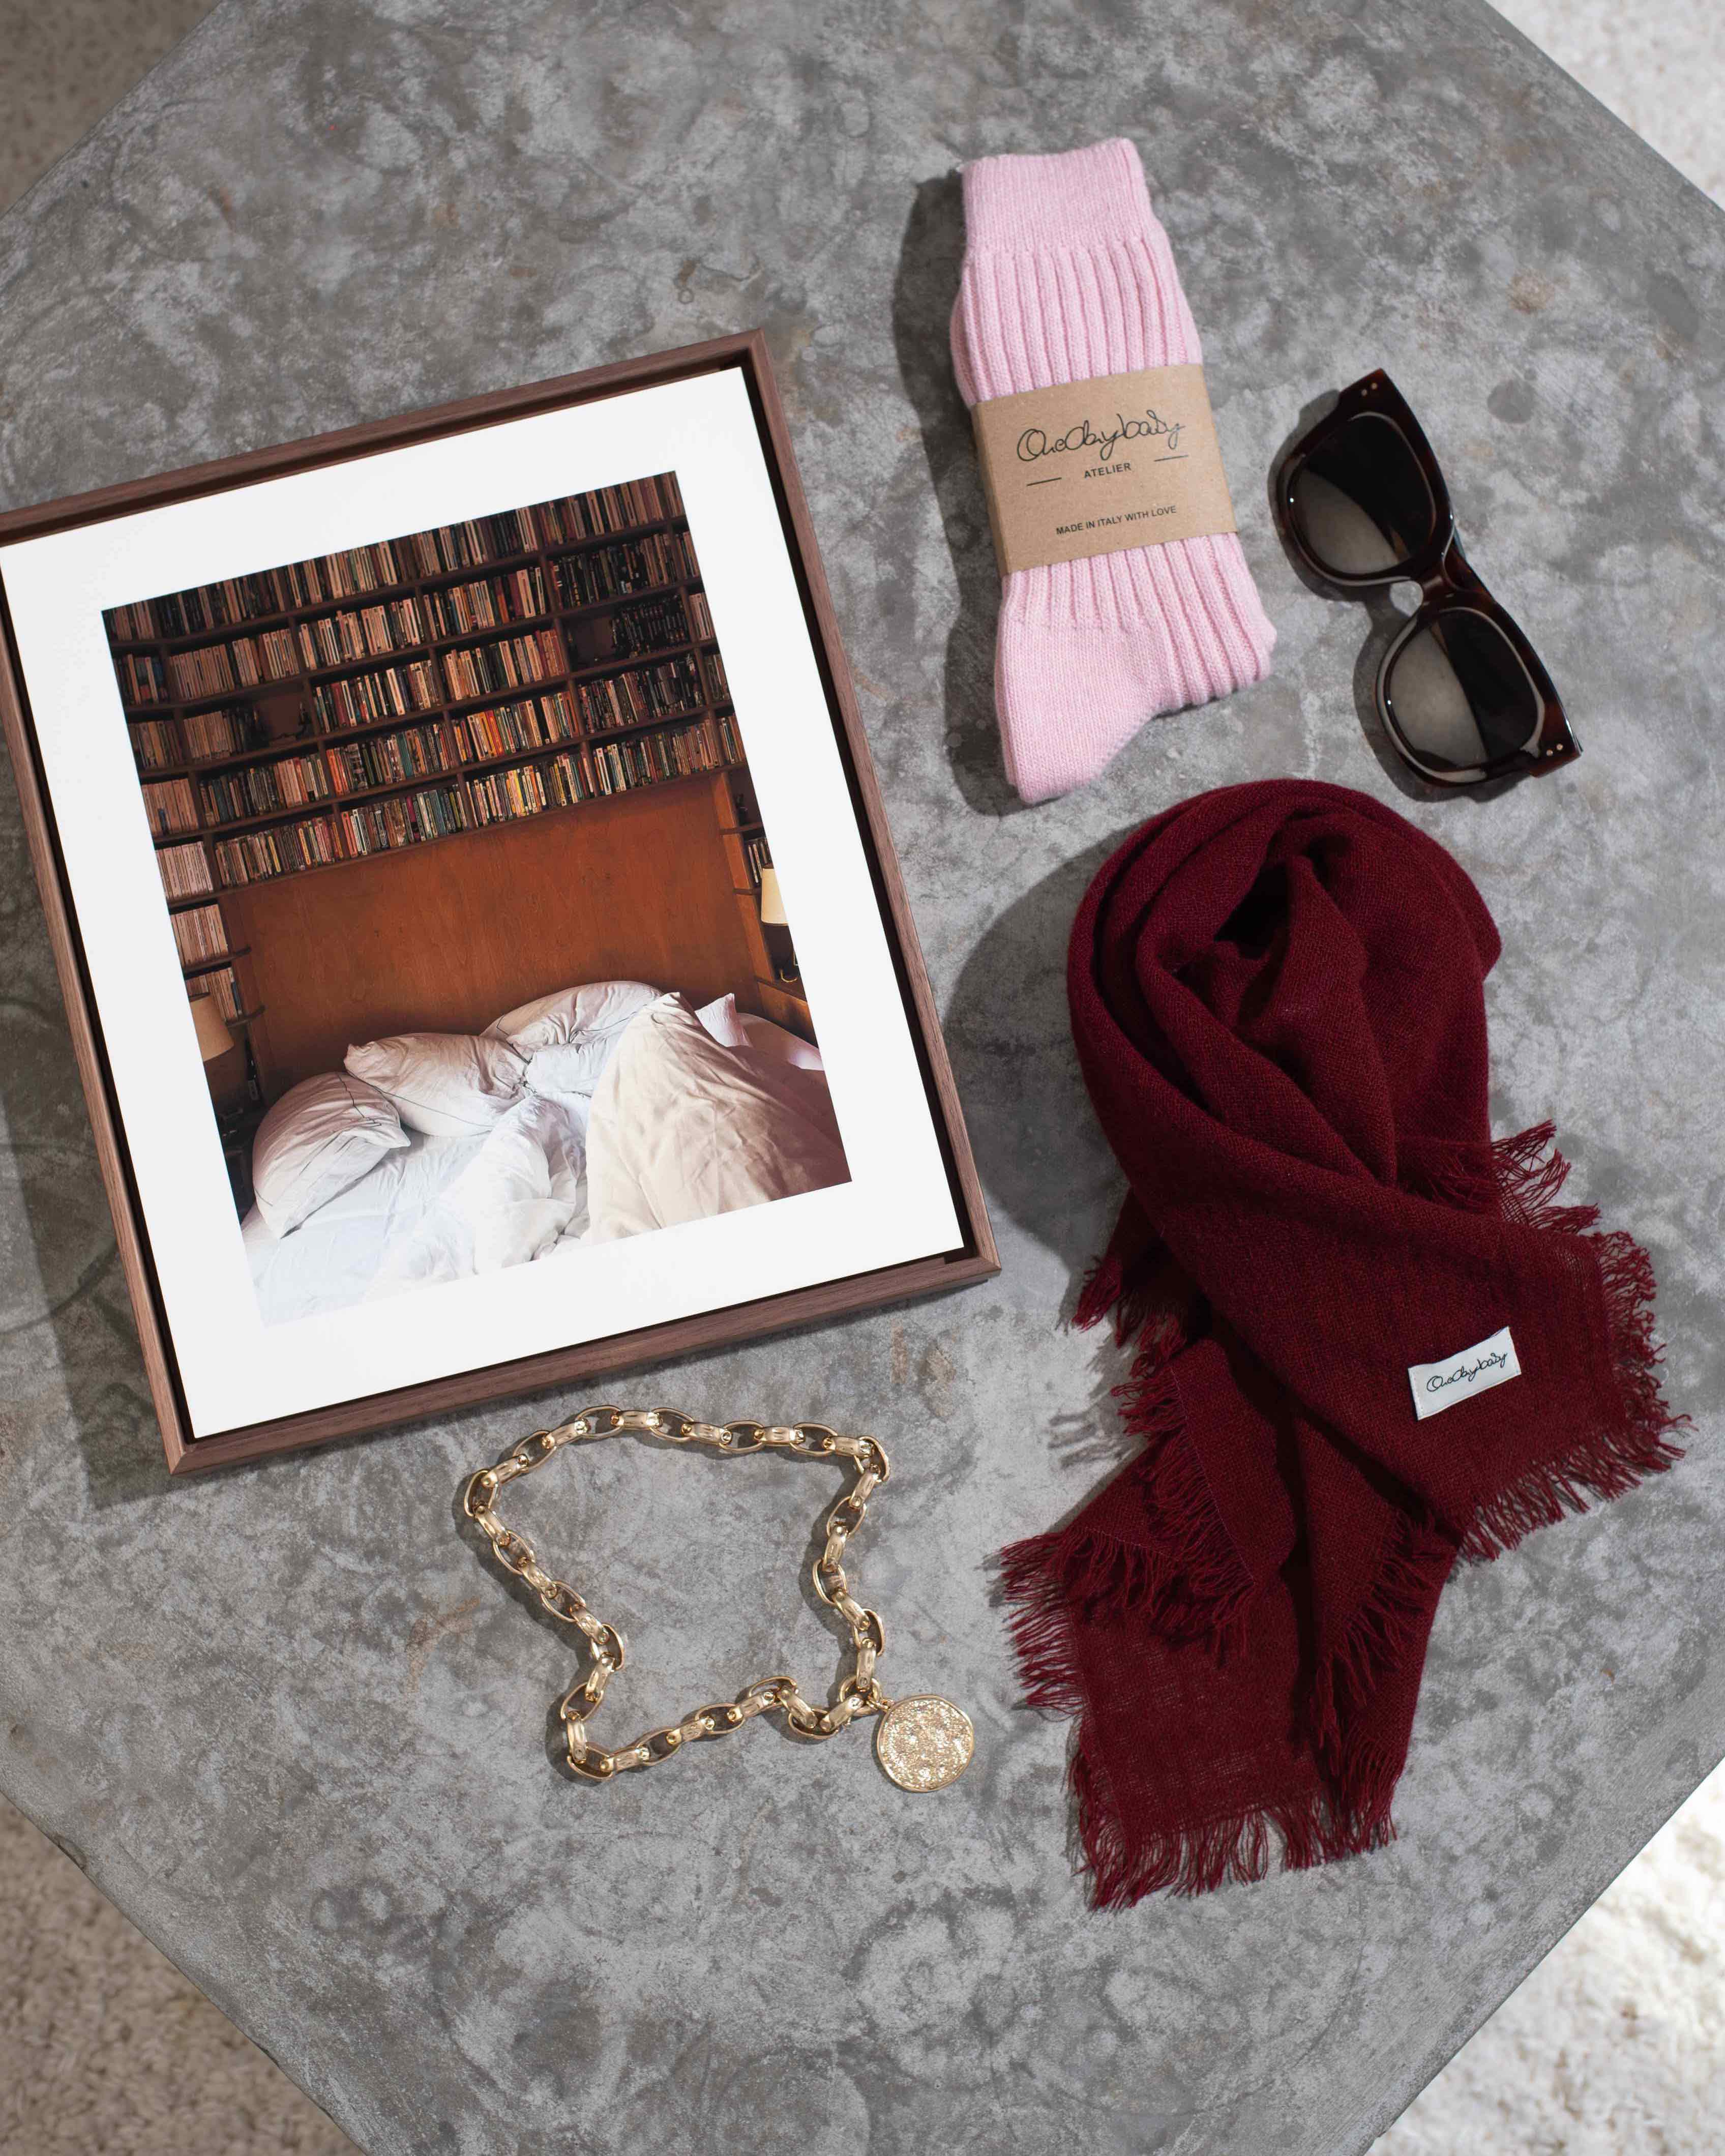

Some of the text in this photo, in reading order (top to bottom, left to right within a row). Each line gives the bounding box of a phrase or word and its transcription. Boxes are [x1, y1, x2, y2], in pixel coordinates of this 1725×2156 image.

[1084, 462, 1132, 479] ATELIER
[1056, 505, 1177, 535] MADE IN ITALY WITH LOVE
